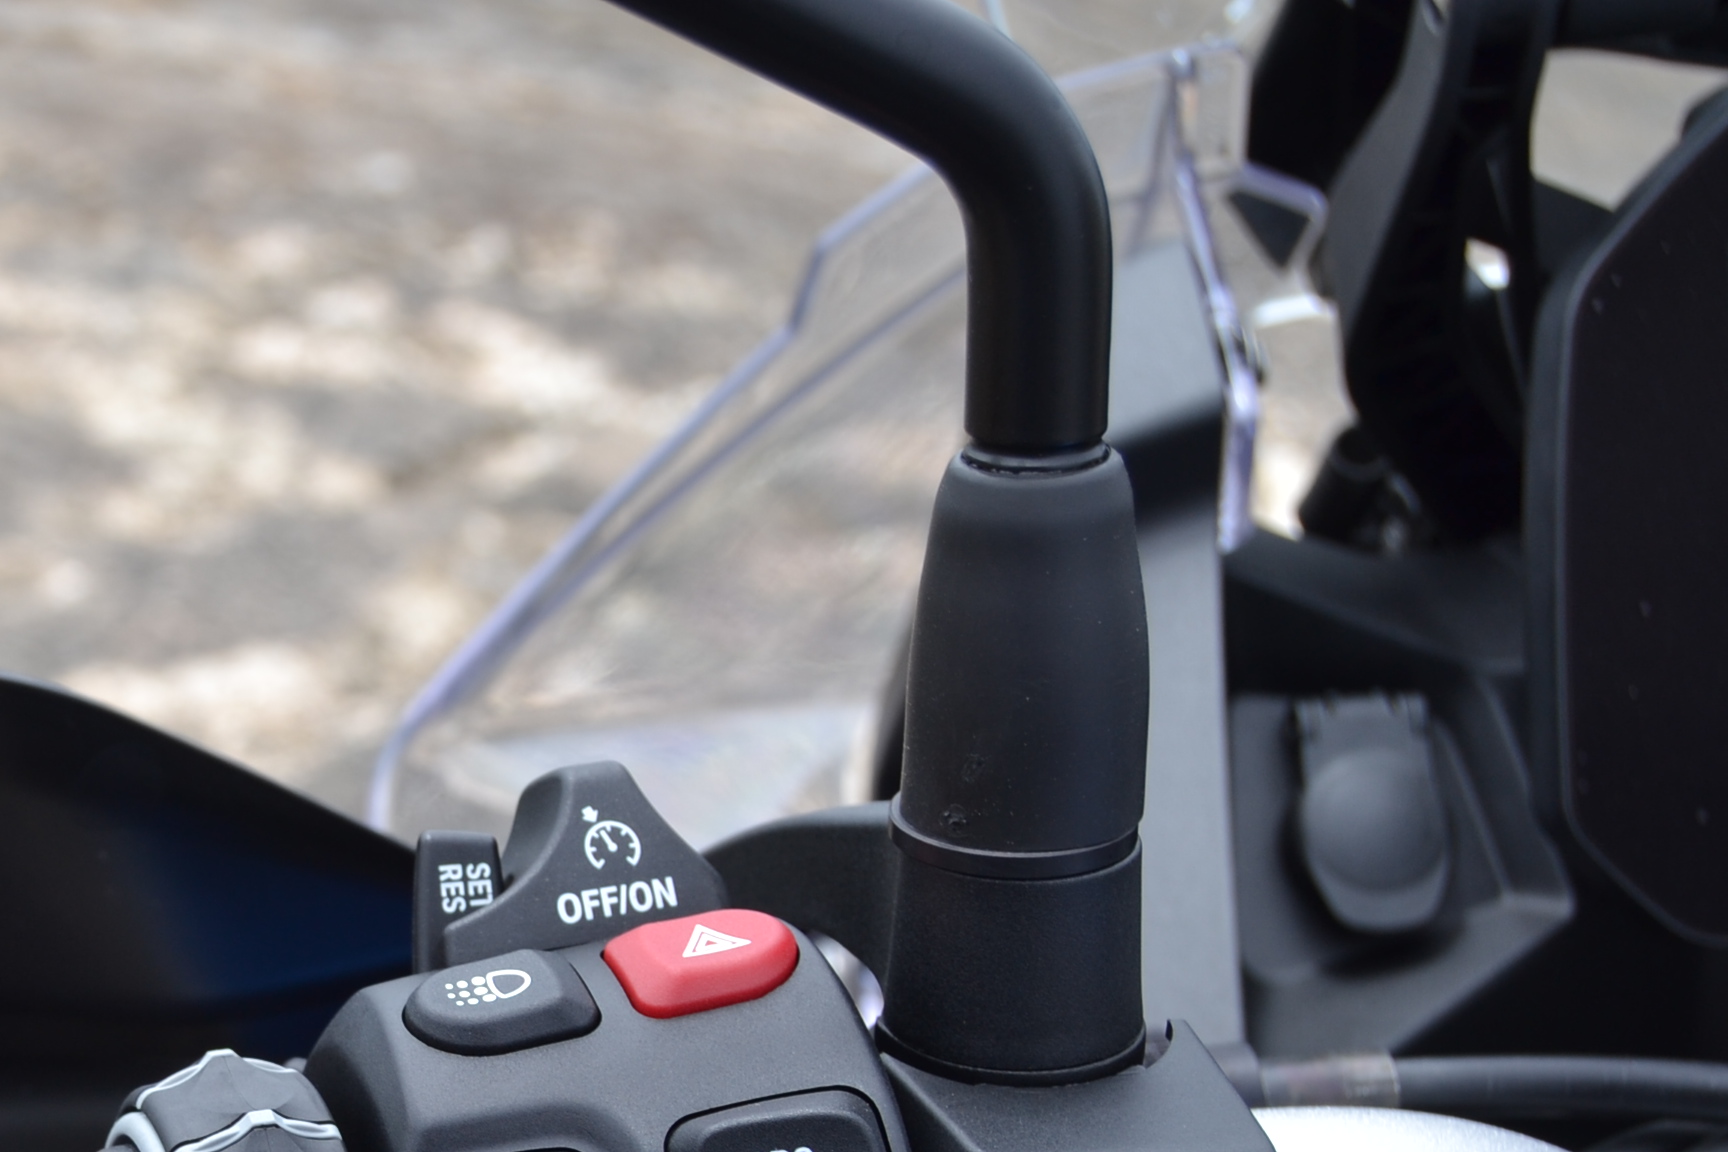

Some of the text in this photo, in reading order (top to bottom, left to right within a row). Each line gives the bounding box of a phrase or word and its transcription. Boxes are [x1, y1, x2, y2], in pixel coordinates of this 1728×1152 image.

[438, 863, 466, 914] RES
[466, 862, 494, 907] SET
[556, 876, 679, 924] OFF/ON
